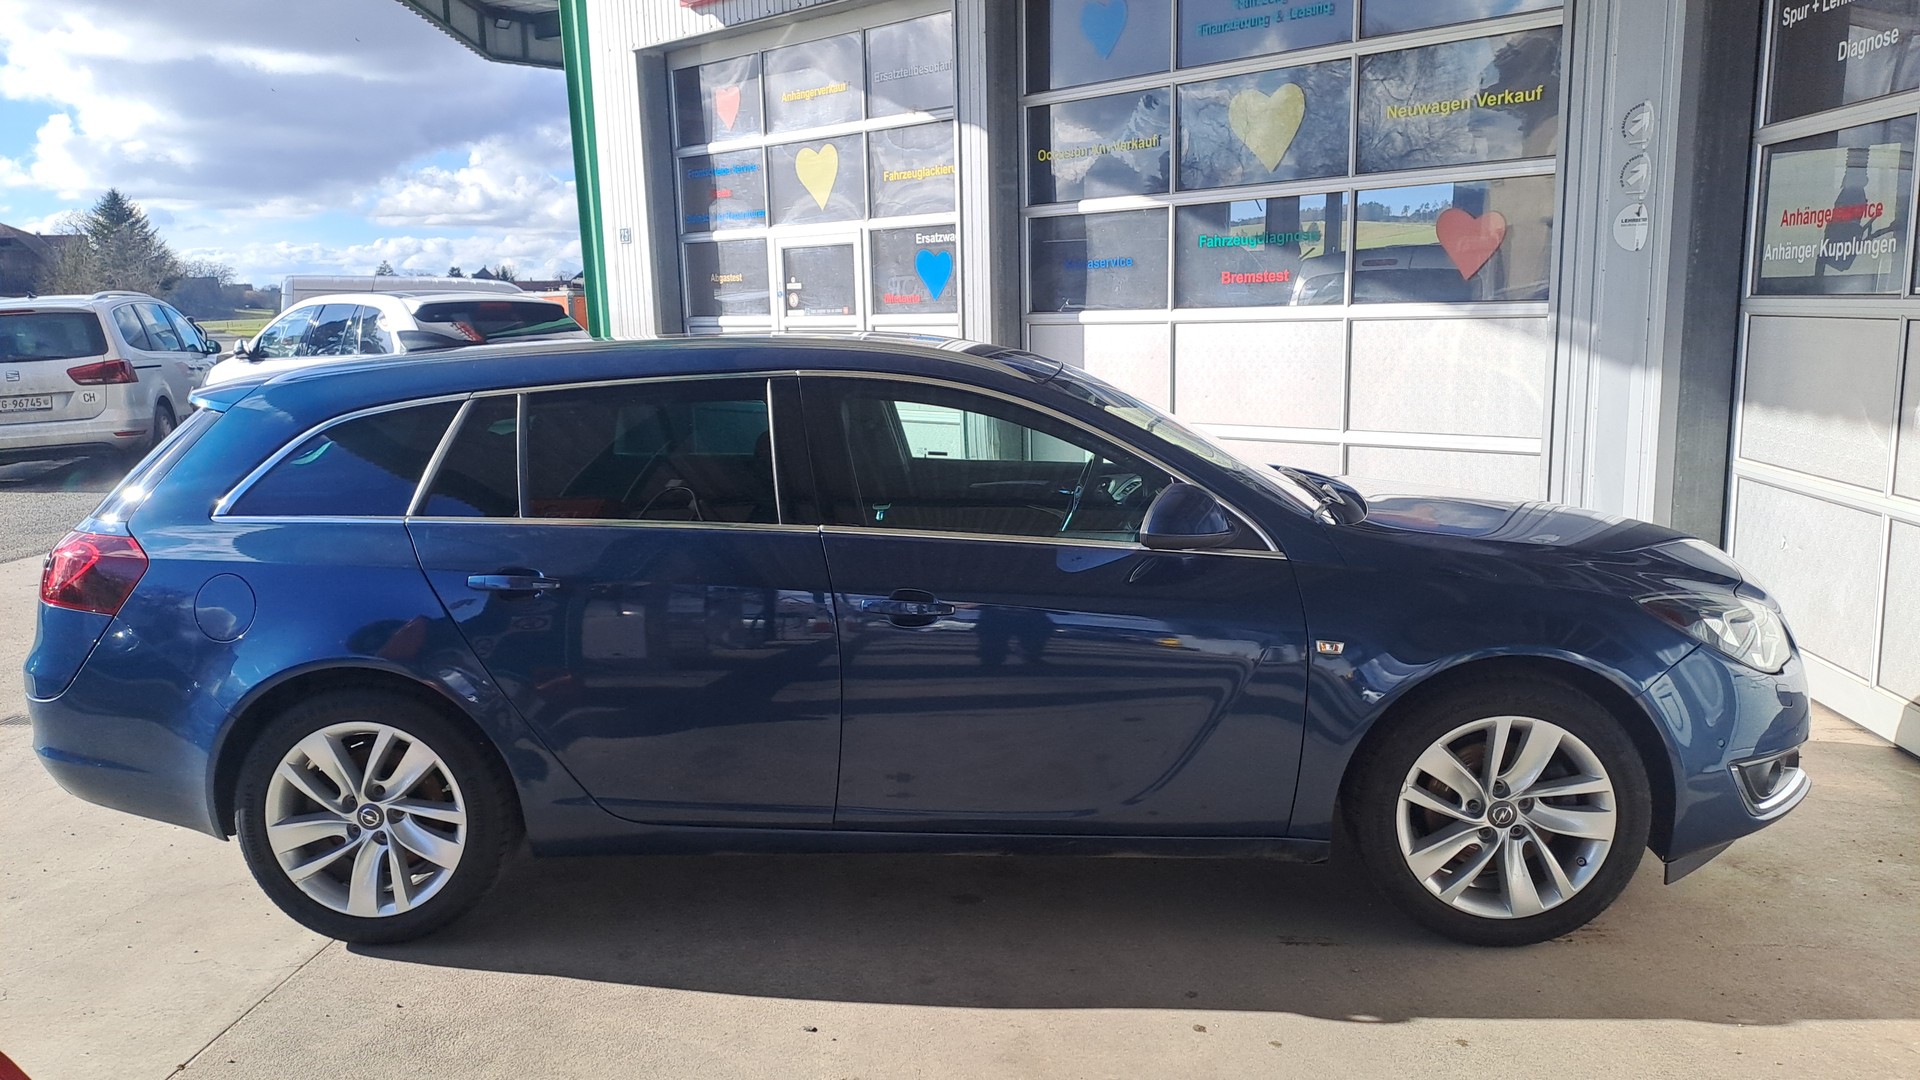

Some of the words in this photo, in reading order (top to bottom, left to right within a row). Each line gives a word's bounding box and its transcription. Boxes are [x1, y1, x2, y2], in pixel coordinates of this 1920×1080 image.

[1782, 4, 1809, 28] Spur
[1812, 0, 1820, 12] +
[1822, 0, 1856, 12] Len
[1838, 28, 1899, 61] Diagnose
[1386, 98, 1470, 119] Neuwagen
[1476, 85, 1544, 108] Verkauf
[1780, 202, 1883, 228] Anhängeice
[916, 232, 957, 244] Ersatzwa
[1198, 230, 1321, 249] Fahrzeugdiagnose
[1763, 242, 1817, 263] Anhänger
[1819, 237, 1897, 261] Kupplungen
[1063, 256, 1134, 269] aservice
[711, 273, 743, 284] Abgastest
[1221, 270, 1290, 285] Bremstest
[83, 392, 96, 403] CH
